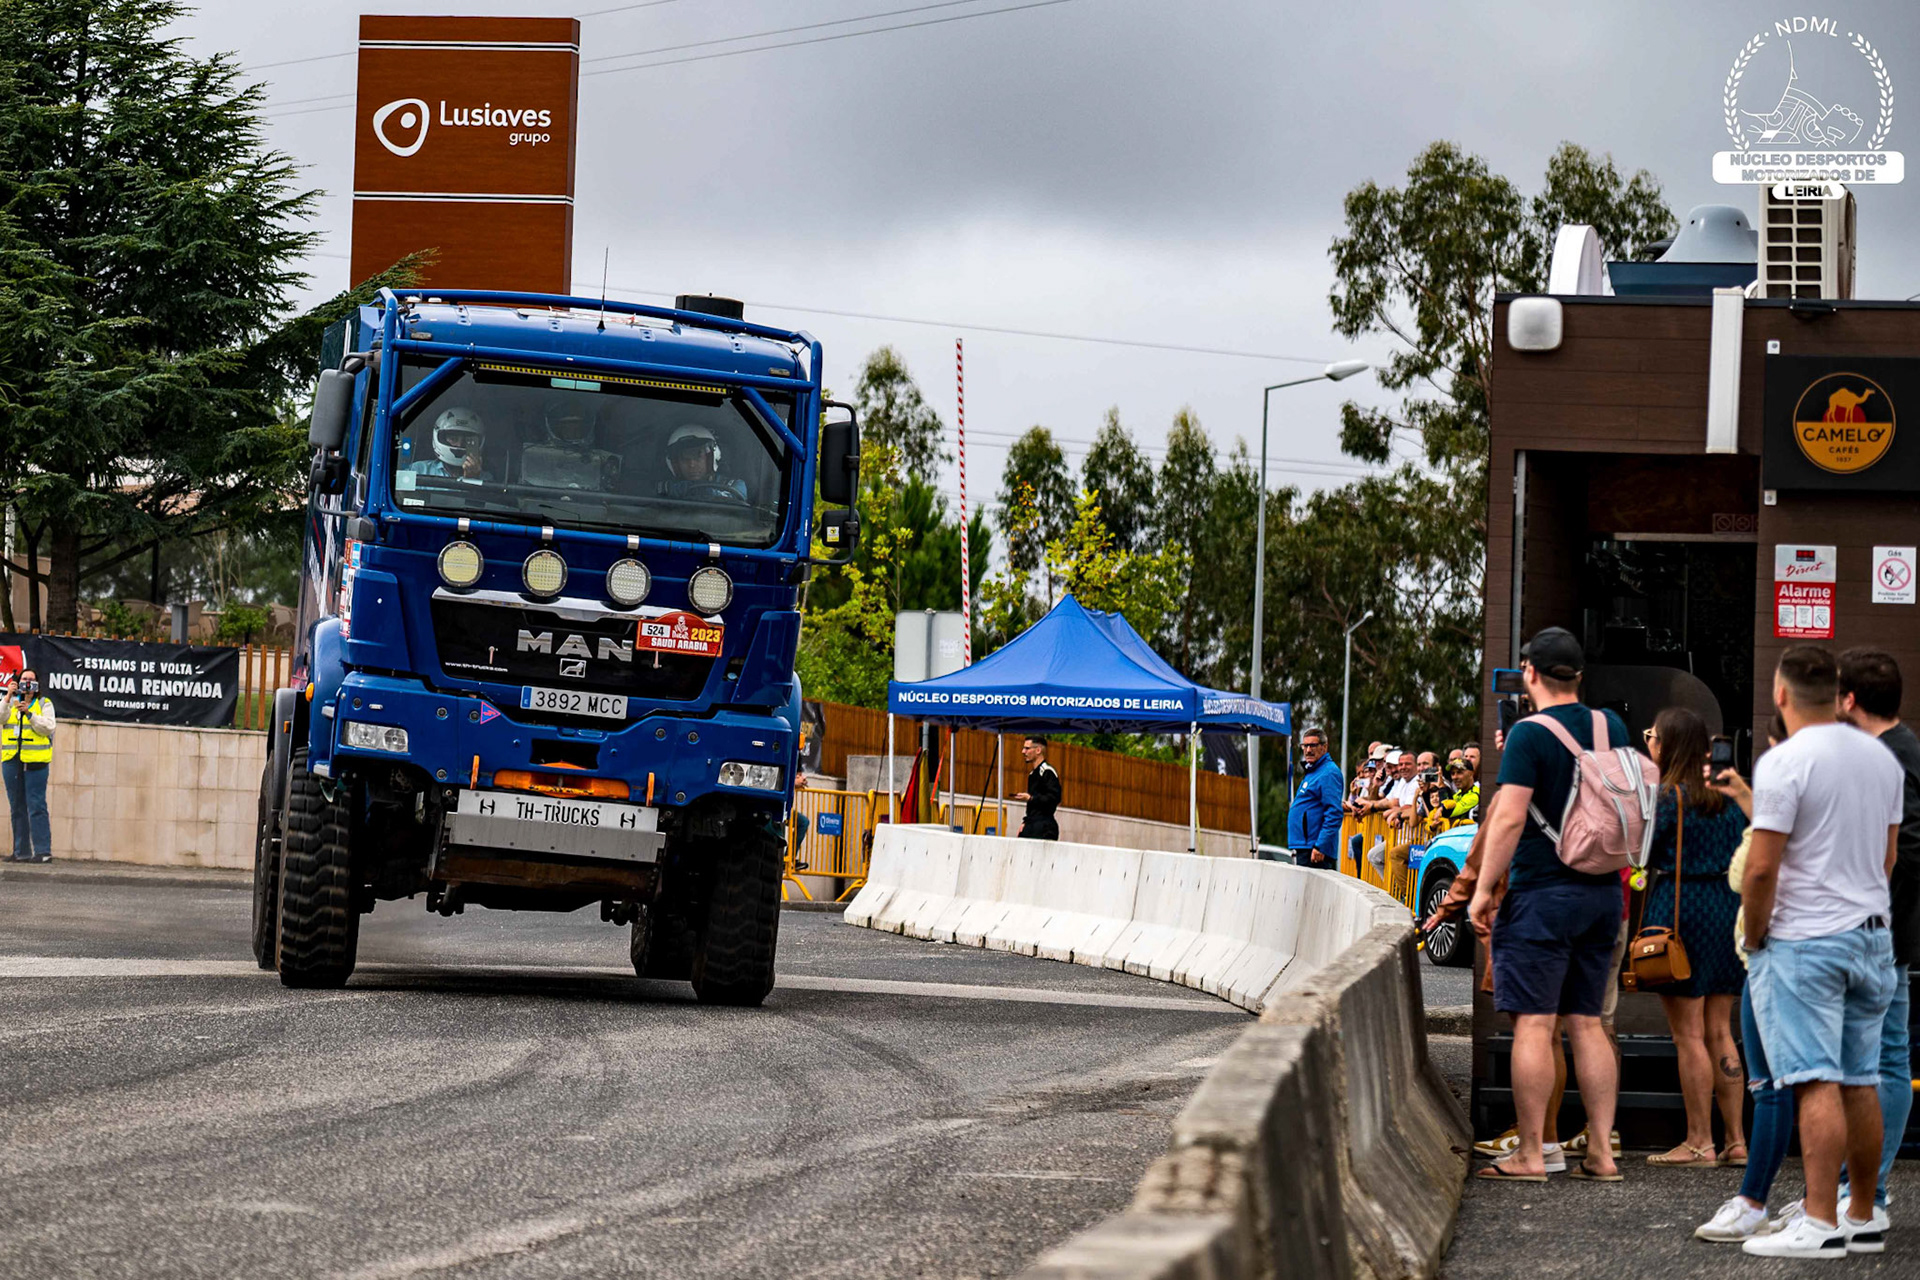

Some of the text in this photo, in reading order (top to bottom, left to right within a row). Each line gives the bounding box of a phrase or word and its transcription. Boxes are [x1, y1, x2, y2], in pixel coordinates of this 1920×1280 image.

[439, 100, 551, 127] Lusiaves
[509, 132, 551, 147] grupo
[1803, 428, 1886, 442] CAMELO
[1828, 446, 1859, 454] CAFÉS
[1785, 561, 1826, 577] Direct
[1779, 584, 1831, 598] Alarme
[646, 625, 721, 643] 524 2023
[516, 629, 634, 662] MAN
[651, 637, 708, 651] SAUDI ARABIA
[84, 657, 193, 675] ESTAMOS DE VOLTA
[49, 672, 223, 699] NOVA LOJA RENOVADA
[104, 699, 170, 711] ESPERAMOS POR SI
[535, 691, 622, 715] 3892 MCC
[898, 690, 1184, 710] NÚCLEO DESPORTOS MOTORIZADOS DE LEIRIA
[516, 802, 600, 826] TH-TRUCKS
